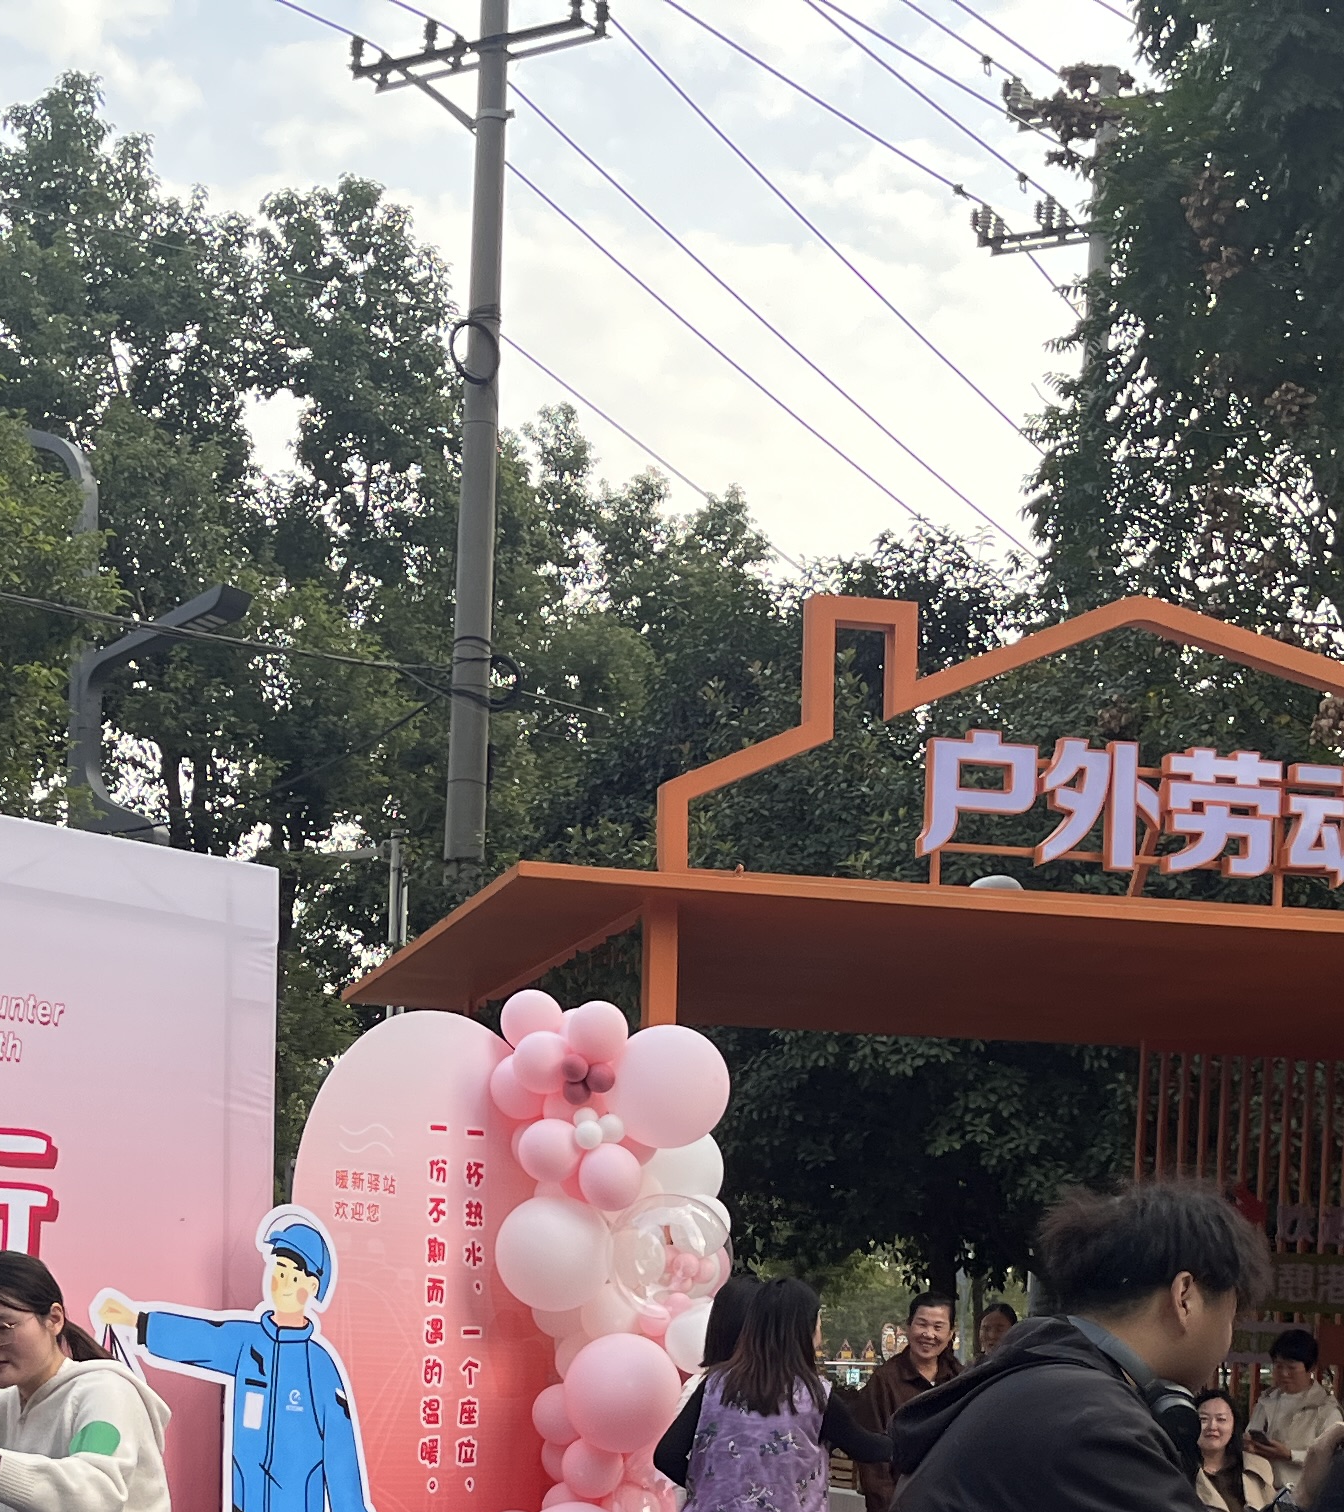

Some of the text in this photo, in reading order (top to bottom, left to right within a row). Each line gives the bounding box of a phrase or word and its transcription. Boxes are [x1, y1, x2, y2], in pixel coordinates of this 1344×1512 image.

[335, 1169, 396, 1194] 暖新驿站
[334, 1201, 380, 1223] 欢迎您
